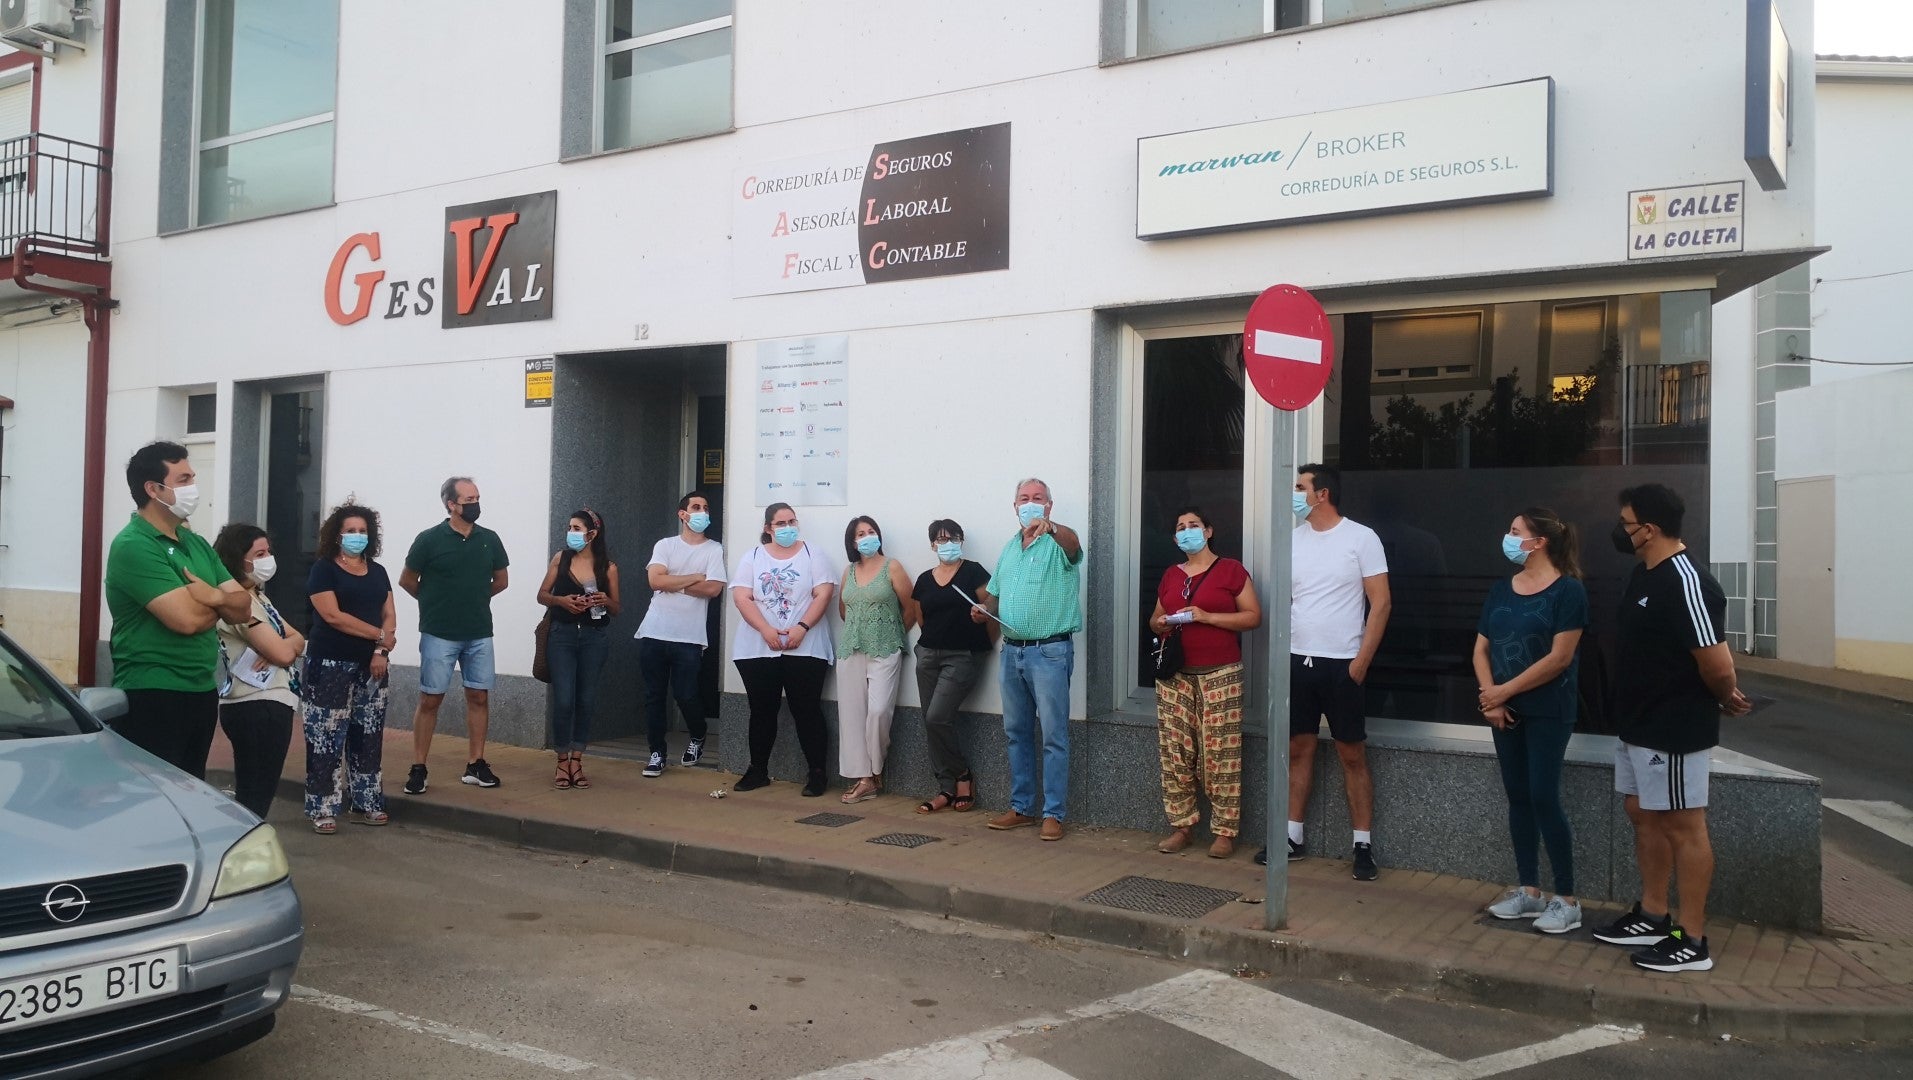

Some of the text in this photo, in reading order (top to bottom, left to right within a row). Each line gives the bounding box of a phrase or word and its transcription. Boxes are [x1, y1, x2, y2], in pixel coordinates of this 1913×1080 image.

[742, 151, 953, 199] CORREDURÍA DE SEGUROS
[1158, 131, 1406, 178] marwan BROKER
[1280, 156, 1519, 197] CORREDURÍA DE SEGUROS S.L.
[771, 197, 952, 238] ASESORÍA LABORAL
[1667, 193, 1739, 218] CALLE
[1635, 227, 1737, 250] LA GOLETA
[781, 241, 967, 279] FISCAL Y CONTABLE
[634, 323, 650, 341] 12
[0, 958, 167, 1024] 2385 BTG
